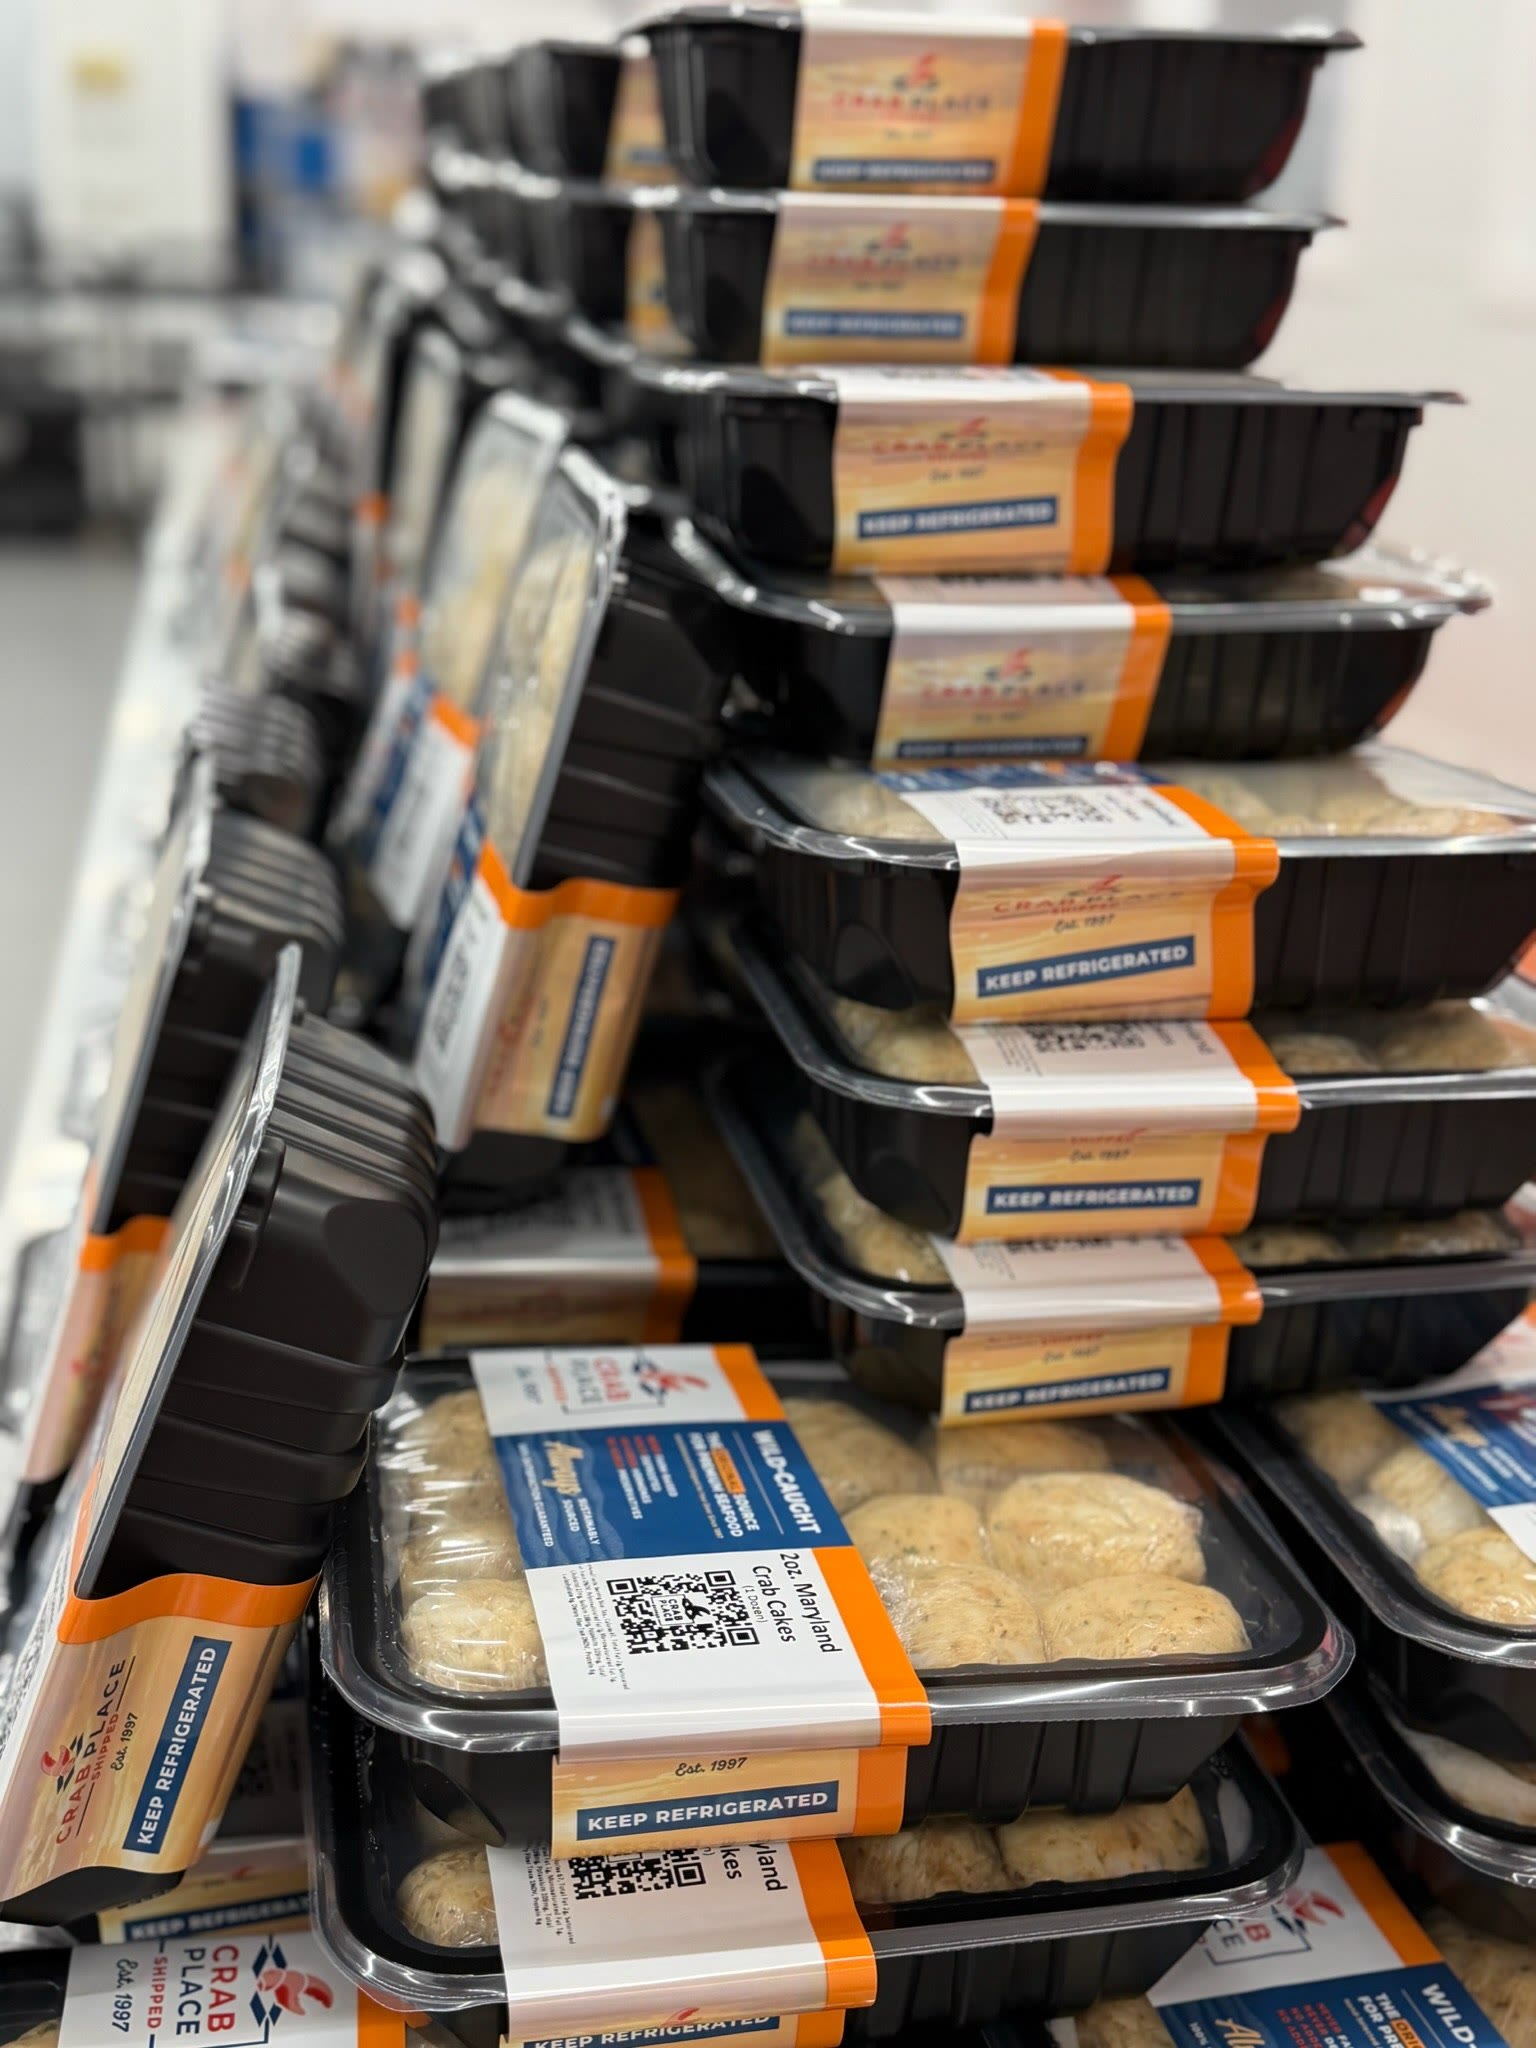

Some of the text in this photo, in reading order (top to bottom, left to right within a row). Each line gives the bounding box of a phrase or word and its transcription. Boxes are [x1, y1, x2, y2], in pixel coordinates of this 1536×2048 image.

[985, 944, 1188, 991] KEEP REFRIGERATED
[993, 1185, 1194, 1208] KEEP REFRIGERATED
[970, 1371, 1165, 1409] KEEP REFRIGERATED
[752, 1429, 822, 1534] WILD-CAUGHT
[534, 1501, 554, 1547] GUARANTEED
[562, 1498, 580, 1532] SOURCED
[577, 1498, 601, 1545] SUSTAINABLY
[714, 1492, 744, 1537] SEAFOOD
[733, 1493, 760, 1531] SOURCE
[668, 1599, 683, 1620] CRAB
[749, 1595, 768, 1623] Dozen)
[752, 1565, 796, 1642] Crab Cakes
[780, 1552, 843, 1652] 2oz. Maryland
[56, 1659, 126, 1844] CRAB PLACE
[91, 1713, 119, 1781] SHIPPED
[110, 1712, 138, 1771] Est. 1997
[137, 1647, 217, 1845] KEEP REFRIGERATED
[674, 1757, 748, 1777] Est. 1997
[588, 1791, 829, 1832] KEEP REFRIGERATED
[132, 1918, 185, 1940] KEEP
[112, 1958, 138, 2033] Est. 1997
[147, 1956, 168, 2029] SHIPPED
[176, 1947, 206, 2035] PLACE
[207, 1945, 240, 2033] CRAB
[1357, 1995, 1384, 2023] FOR
[1375, 1992, 1402, 2019] THE
